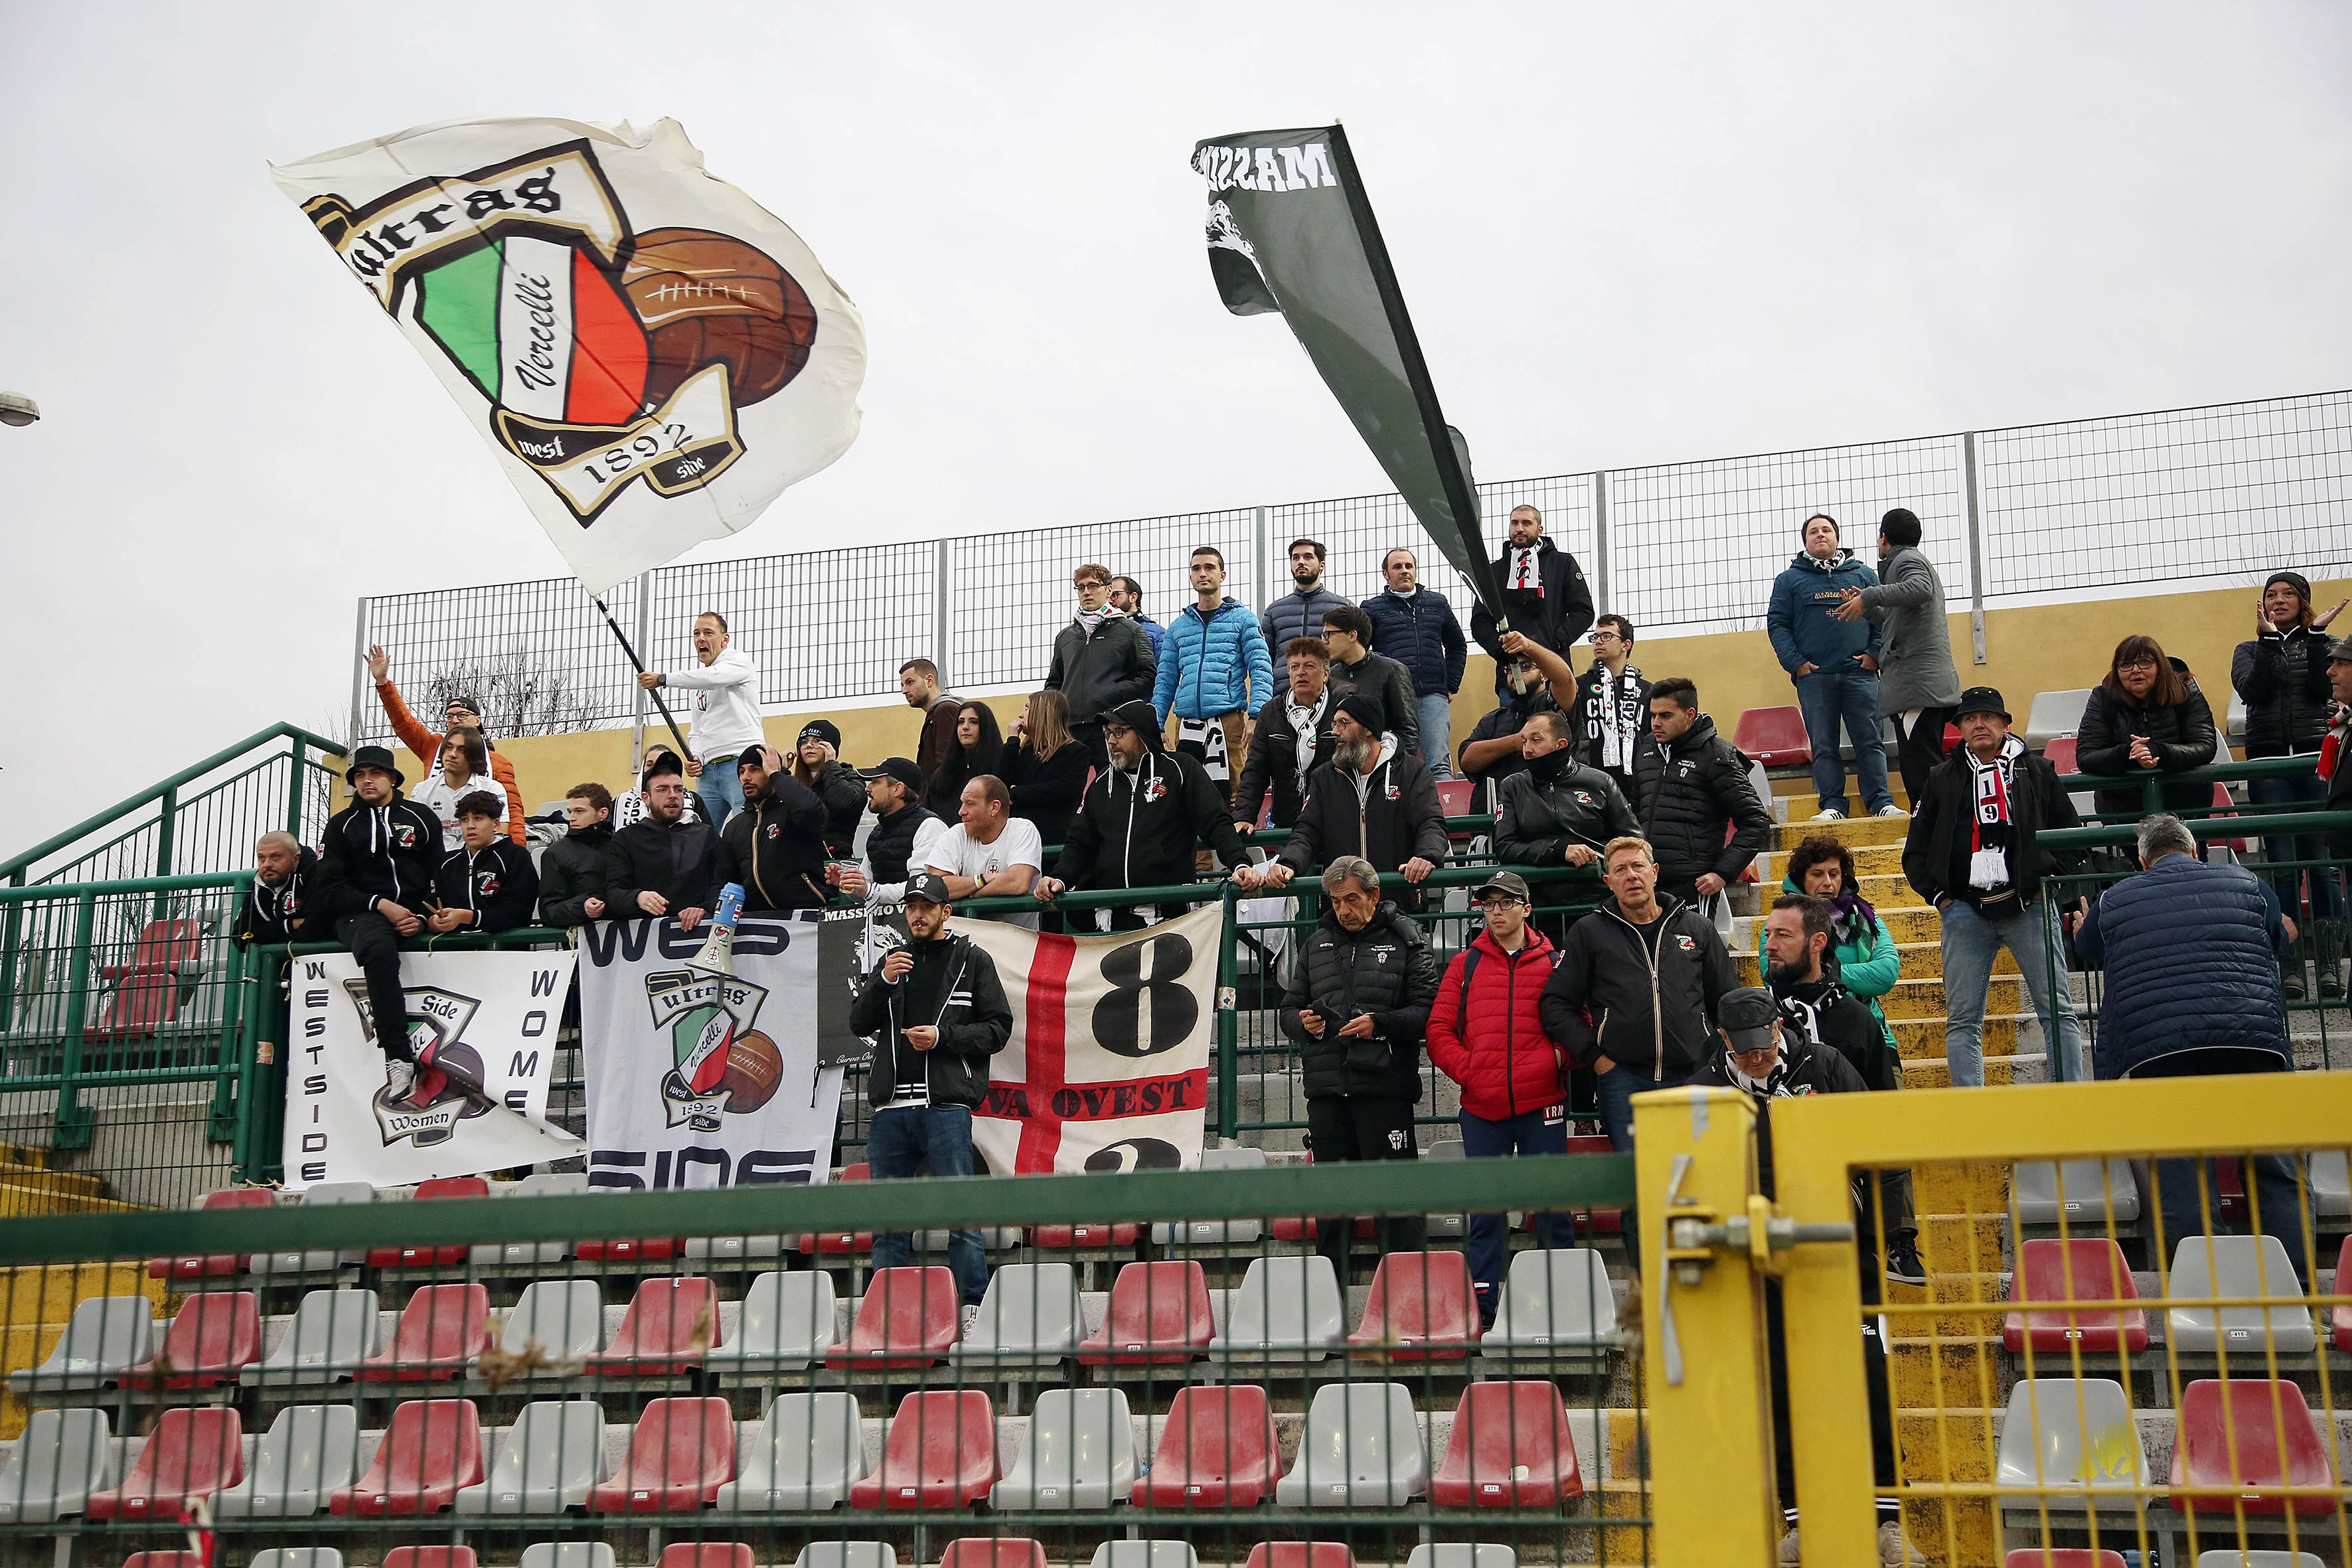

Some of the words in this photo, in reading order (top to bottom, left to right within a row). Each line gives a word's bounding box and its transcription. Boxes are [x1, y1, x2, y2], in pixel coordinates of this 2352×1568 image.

[514, 272, 554, 390] Vercelli
[518, 433, 565, 461] west
[584, 423, 694, 484] 1892
[676, 455, 706, 479] side
[421, 994, 458, 1020] Side
[1092, 933, 1198, 1058] 8
[836, 1054, 860, 1064] Curva
[682, 1102, 718, 1116] 1892
[1052, 1076, 1192, 1118] OVEST
[390, 1113, 449, 1131] Women
[694, 1117, 710, 1127] side
